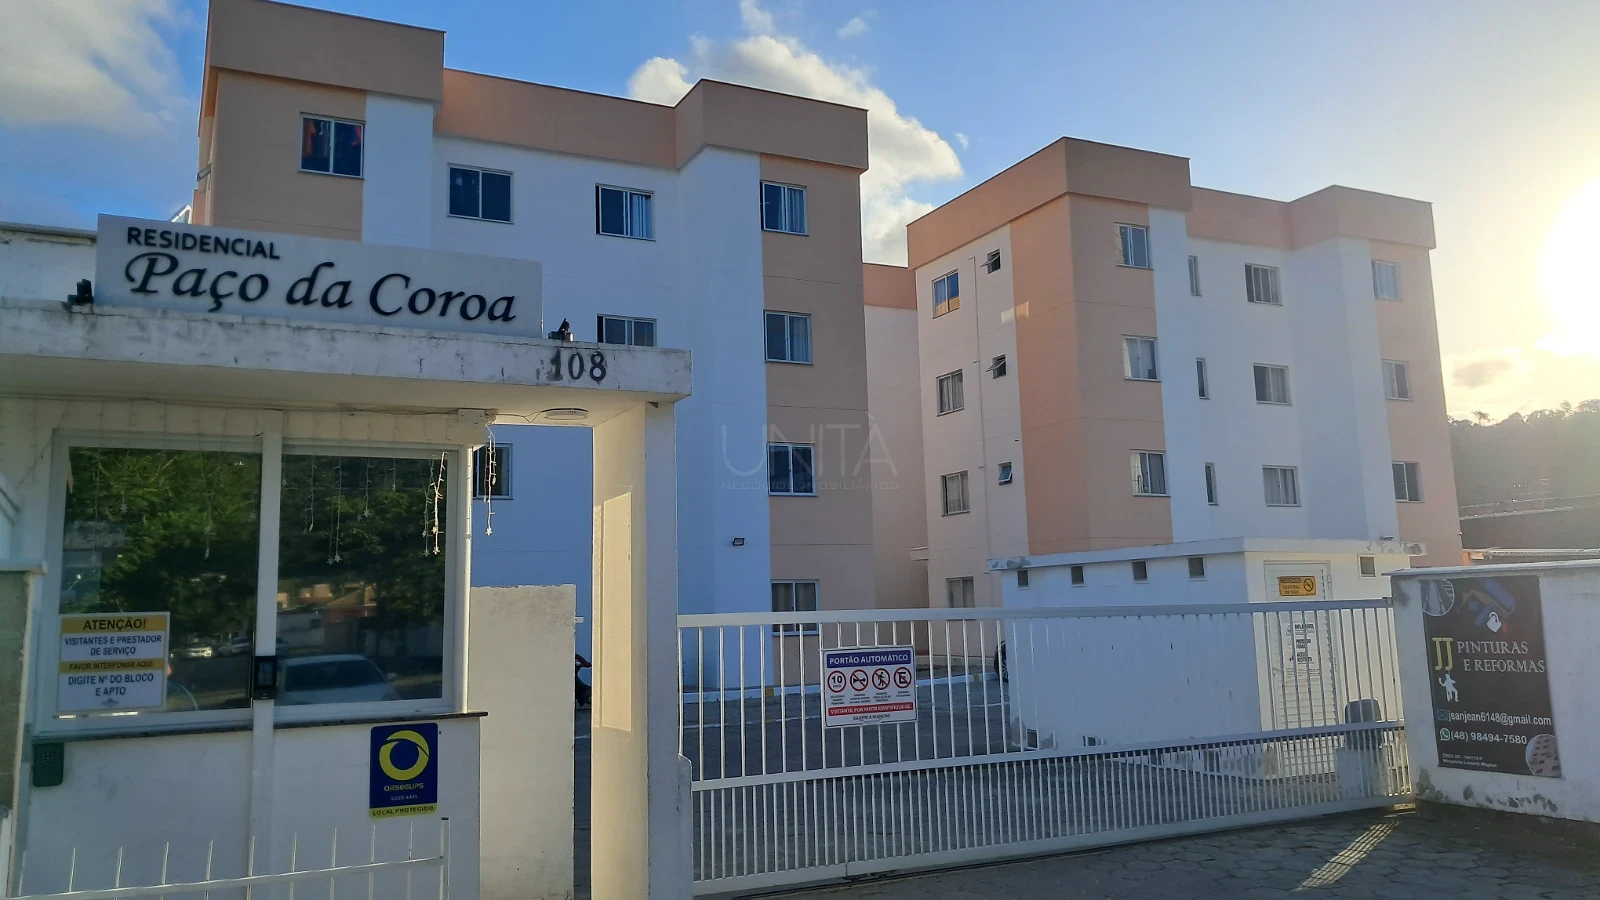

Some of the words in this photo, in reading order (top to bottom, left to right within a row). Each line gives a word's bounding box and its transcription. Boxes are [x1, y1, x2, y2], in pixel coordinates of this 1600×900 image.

[126, 226, 280, 260] RESIDENCIAL
[124, 251, 269, 313] Paço
[286, 262, 353, 309] da
[369, 273, 516, 323] Coroa
[549, 347, 607, 382] 108
[83, 616, 146, 632] ATENÇÃO!
[64, 636, 108, 646] VISITANTES
[110, 636, 114, 644] E
[116, 634, 162, 644] PRESTADOR
[1457, 640, 1528, 654] PINTURAS
[90, 647, 100, 656] DE
[103, 646, 136, 656] SERVIÇO
[1432, 637, 1454, 671] JJ
[69, 663, 92, 671] FAVOR
[93, 661, 136, 670] INTERFONAR
[830, 656, 859, 665] PORTÃO
[860, 653, 908, 663] AUTOMÁTICO
[1464, 660, 1471, 672] E
[1474, 659, 1545, 673] REFORMAS
[68, 676, 96, 685] DIGITE
[110, 675, 122, 684] DO
[124, 673, 154, 682] BLOCO
[832, 675, 842, 684] 10
[96, 688, 100, 696] E
[103, 687, 126, 695] APTO
[1448, 710, 1552, 726] jeanjean6148@gmail.com
[1451, 730, 1468, 742] (48)
[1470, 732, 1527, 745] 98494-7580
